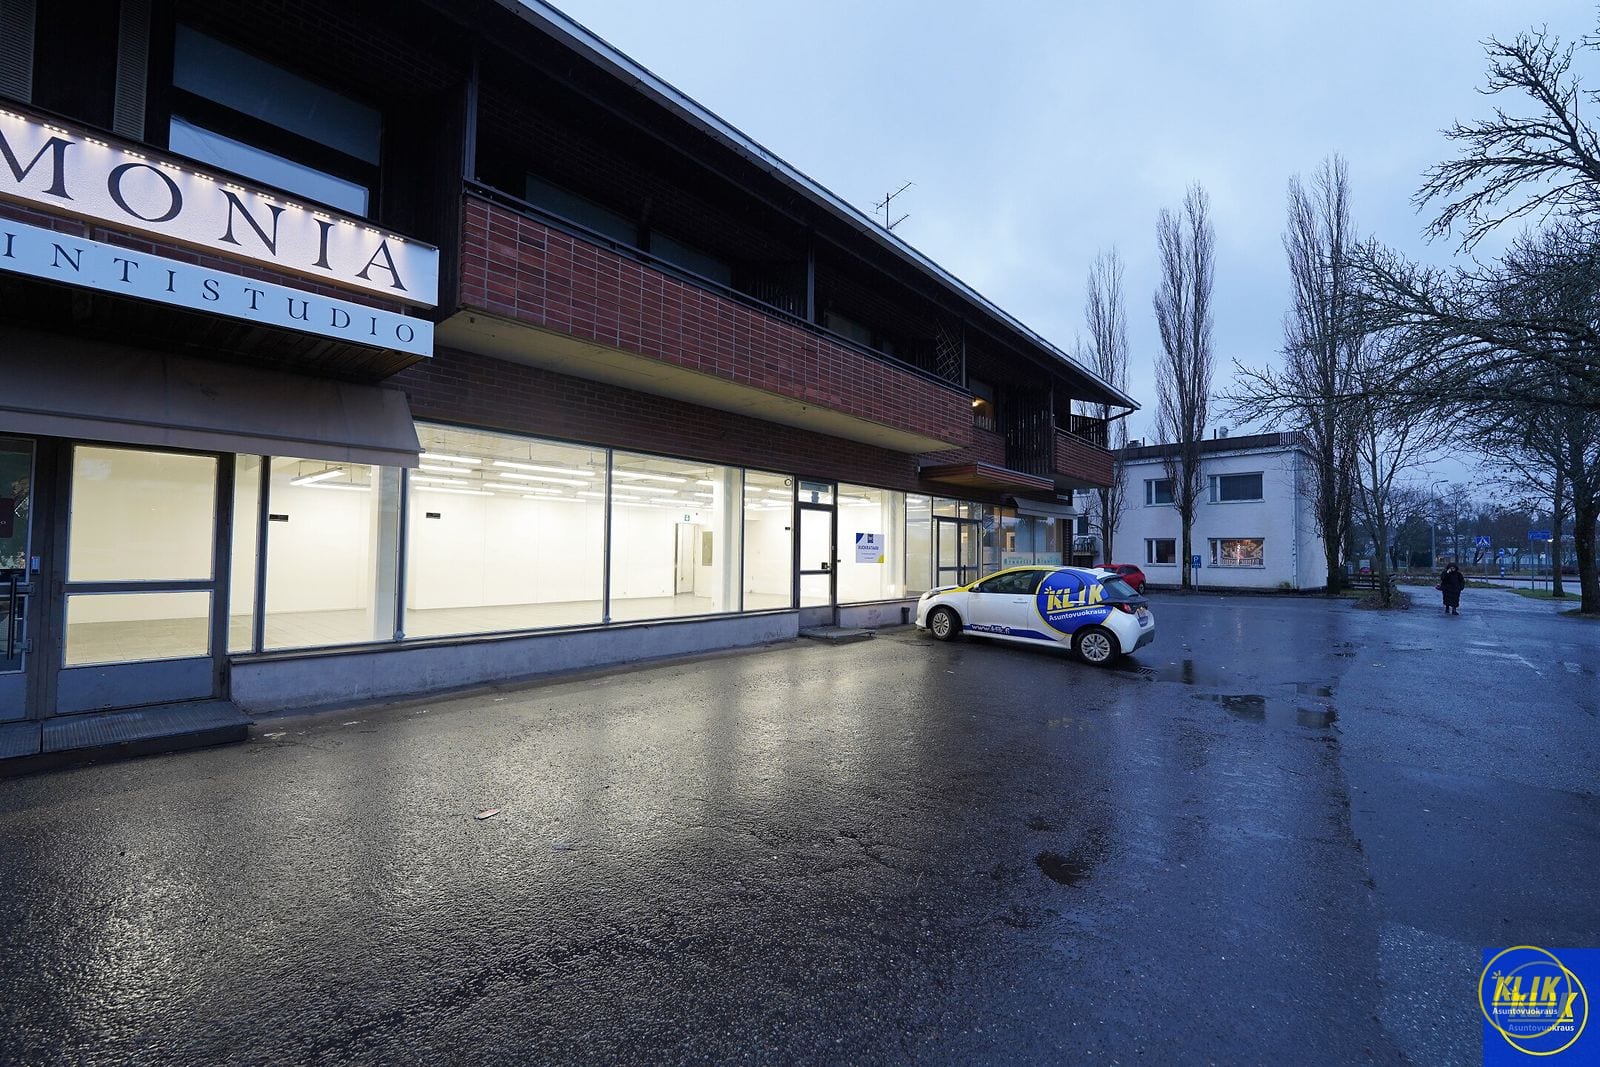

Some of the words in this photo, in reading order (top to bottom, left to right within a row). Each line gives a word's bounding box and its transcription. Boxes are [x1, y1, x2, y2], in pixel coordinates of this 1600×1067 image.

[0, 128, 409, 292] MONIA
[2, 231, 416, 344] INTISTUDIO
[1047, 584, 1104, 610] KLIK
[1049, 609, 1107, 622] Asuntovuokraus
